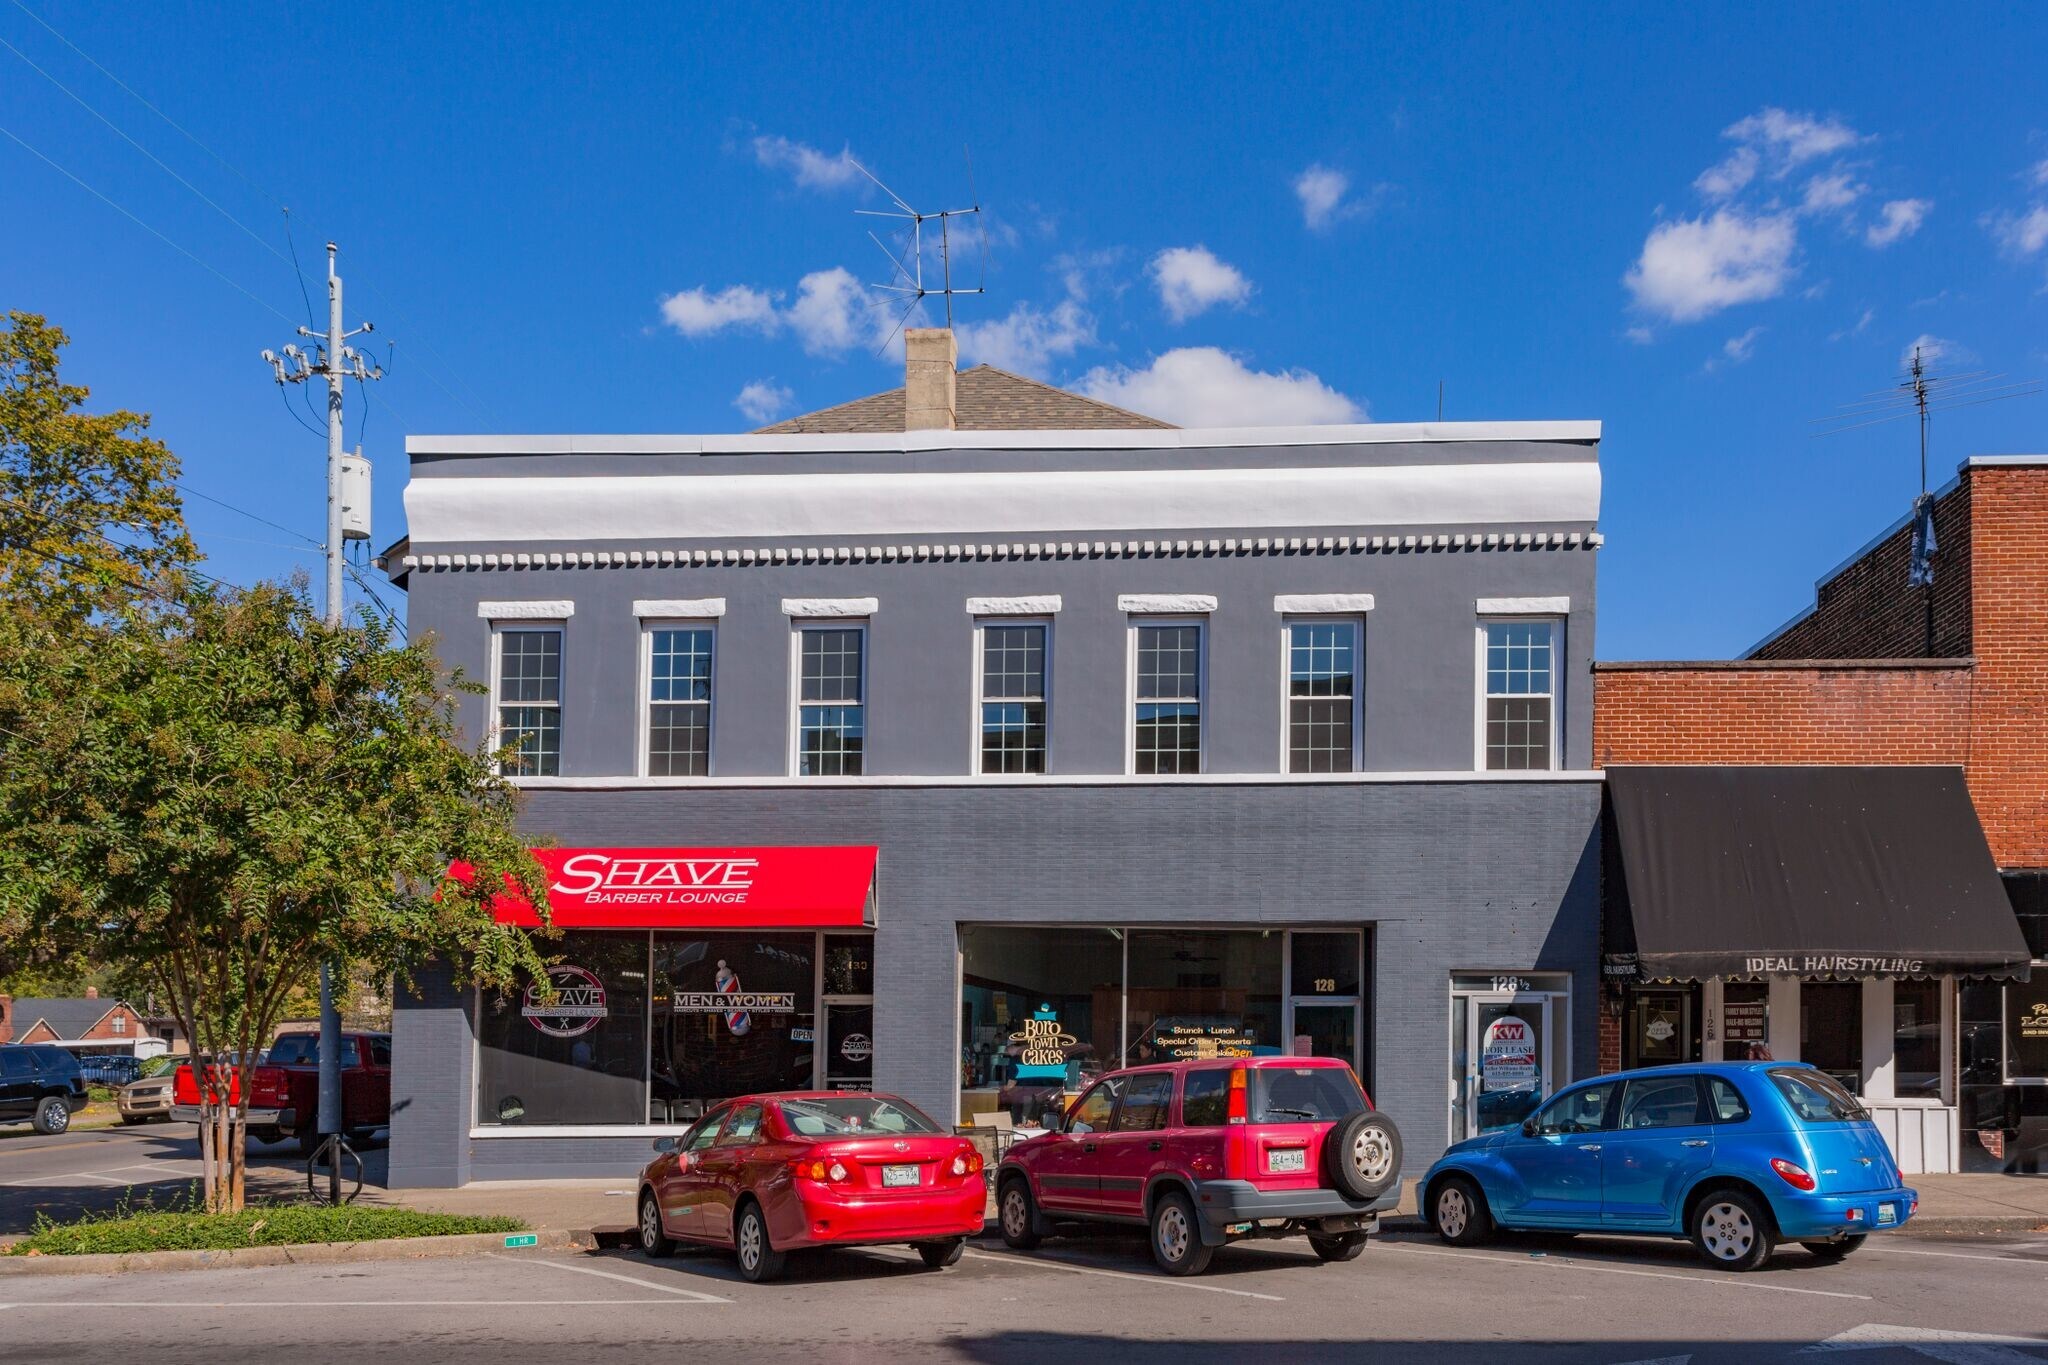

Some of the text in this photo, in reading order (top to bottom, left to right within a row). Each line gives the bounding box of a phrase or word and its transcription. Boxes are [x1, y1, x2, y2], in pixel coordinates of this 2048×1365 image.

[551, 854, 759, 894] SHAVE
[585, 892, 748, 903] BARBER LOUNGE
[1746, 957, 1923, 972] IDEAL HAIRSTYLING
[1314, 979, 1335, 992] 128
[674, 995, 795, 1007] MEN & WOMEN
[1024, 1019, 1061, 1038] Boro
[1173, 1026, 1236, 1034] Brunch Lunch
[1493, 1026, 1523, 1039] KW
[793, 1029, 813, 1040] OPEN
[1157, 1037, 1187, 1046] Special
[1214, 1037, 1251, 1045] Desserts
[1173, 1049, 1207, 1057] Custom
[1485, 1046, 1534, 1054] FOR LEASE
